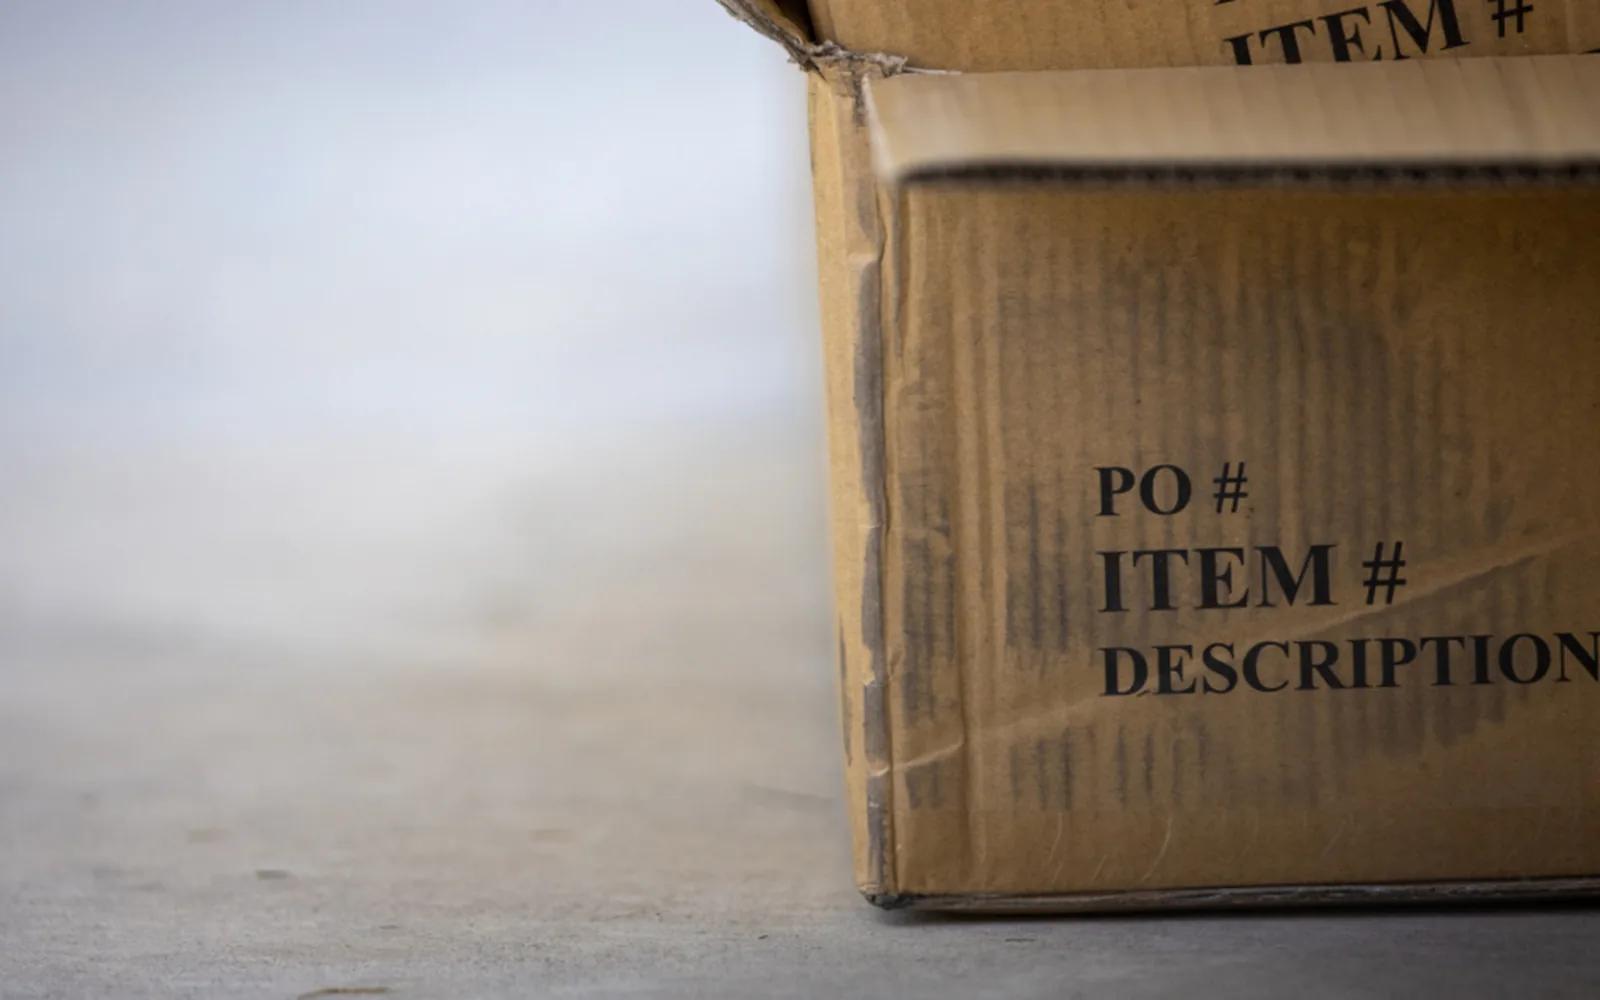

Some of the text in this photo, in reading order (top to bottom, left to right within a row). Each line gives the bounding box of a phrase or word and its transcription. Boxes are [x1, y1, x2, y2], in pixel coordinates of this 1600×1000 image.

[1095, 461, 1249, 517] PO #
[1097, 540, 1407, 613] ITEM #
[1098, 631, 1600, 697] DESCRIPTION
